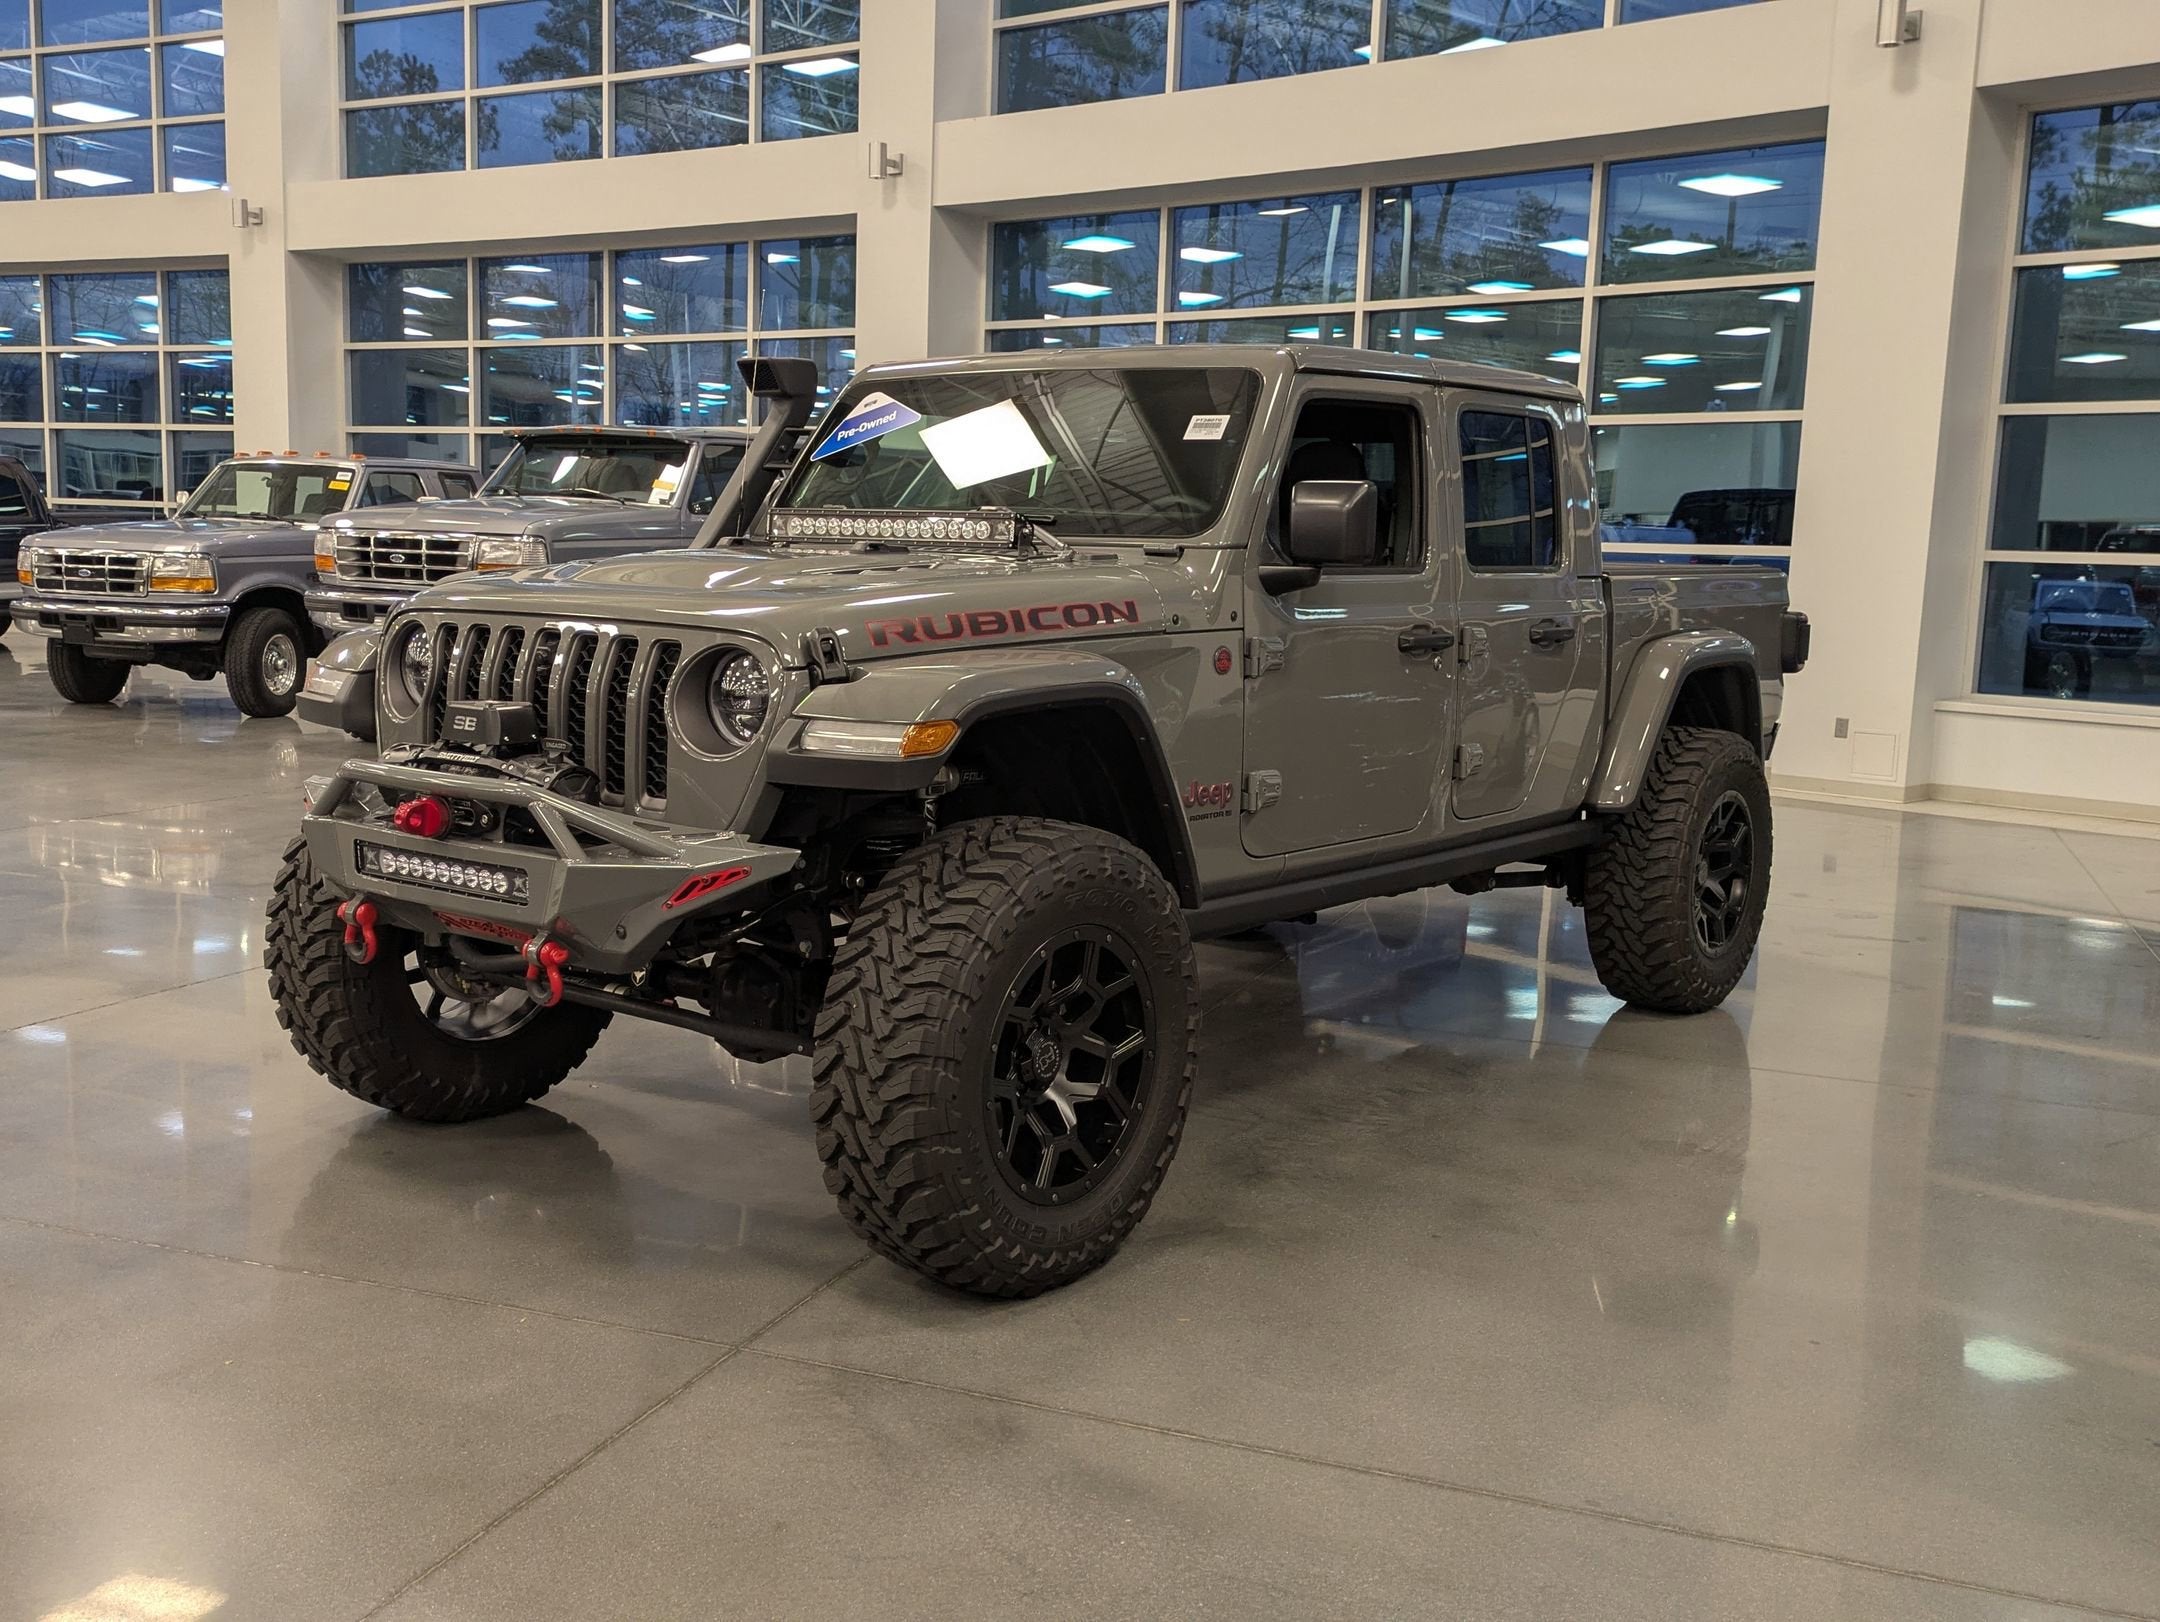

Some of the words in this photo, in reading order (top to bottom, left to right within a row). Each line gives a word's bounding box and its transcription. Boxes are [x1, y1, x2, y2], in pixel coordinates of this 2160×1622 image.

[837, 410, 898, 442] Pre-Owned
[865, 600, 1140, 650] RUBICON
[1183, 780, 1233, 809] Jeep
